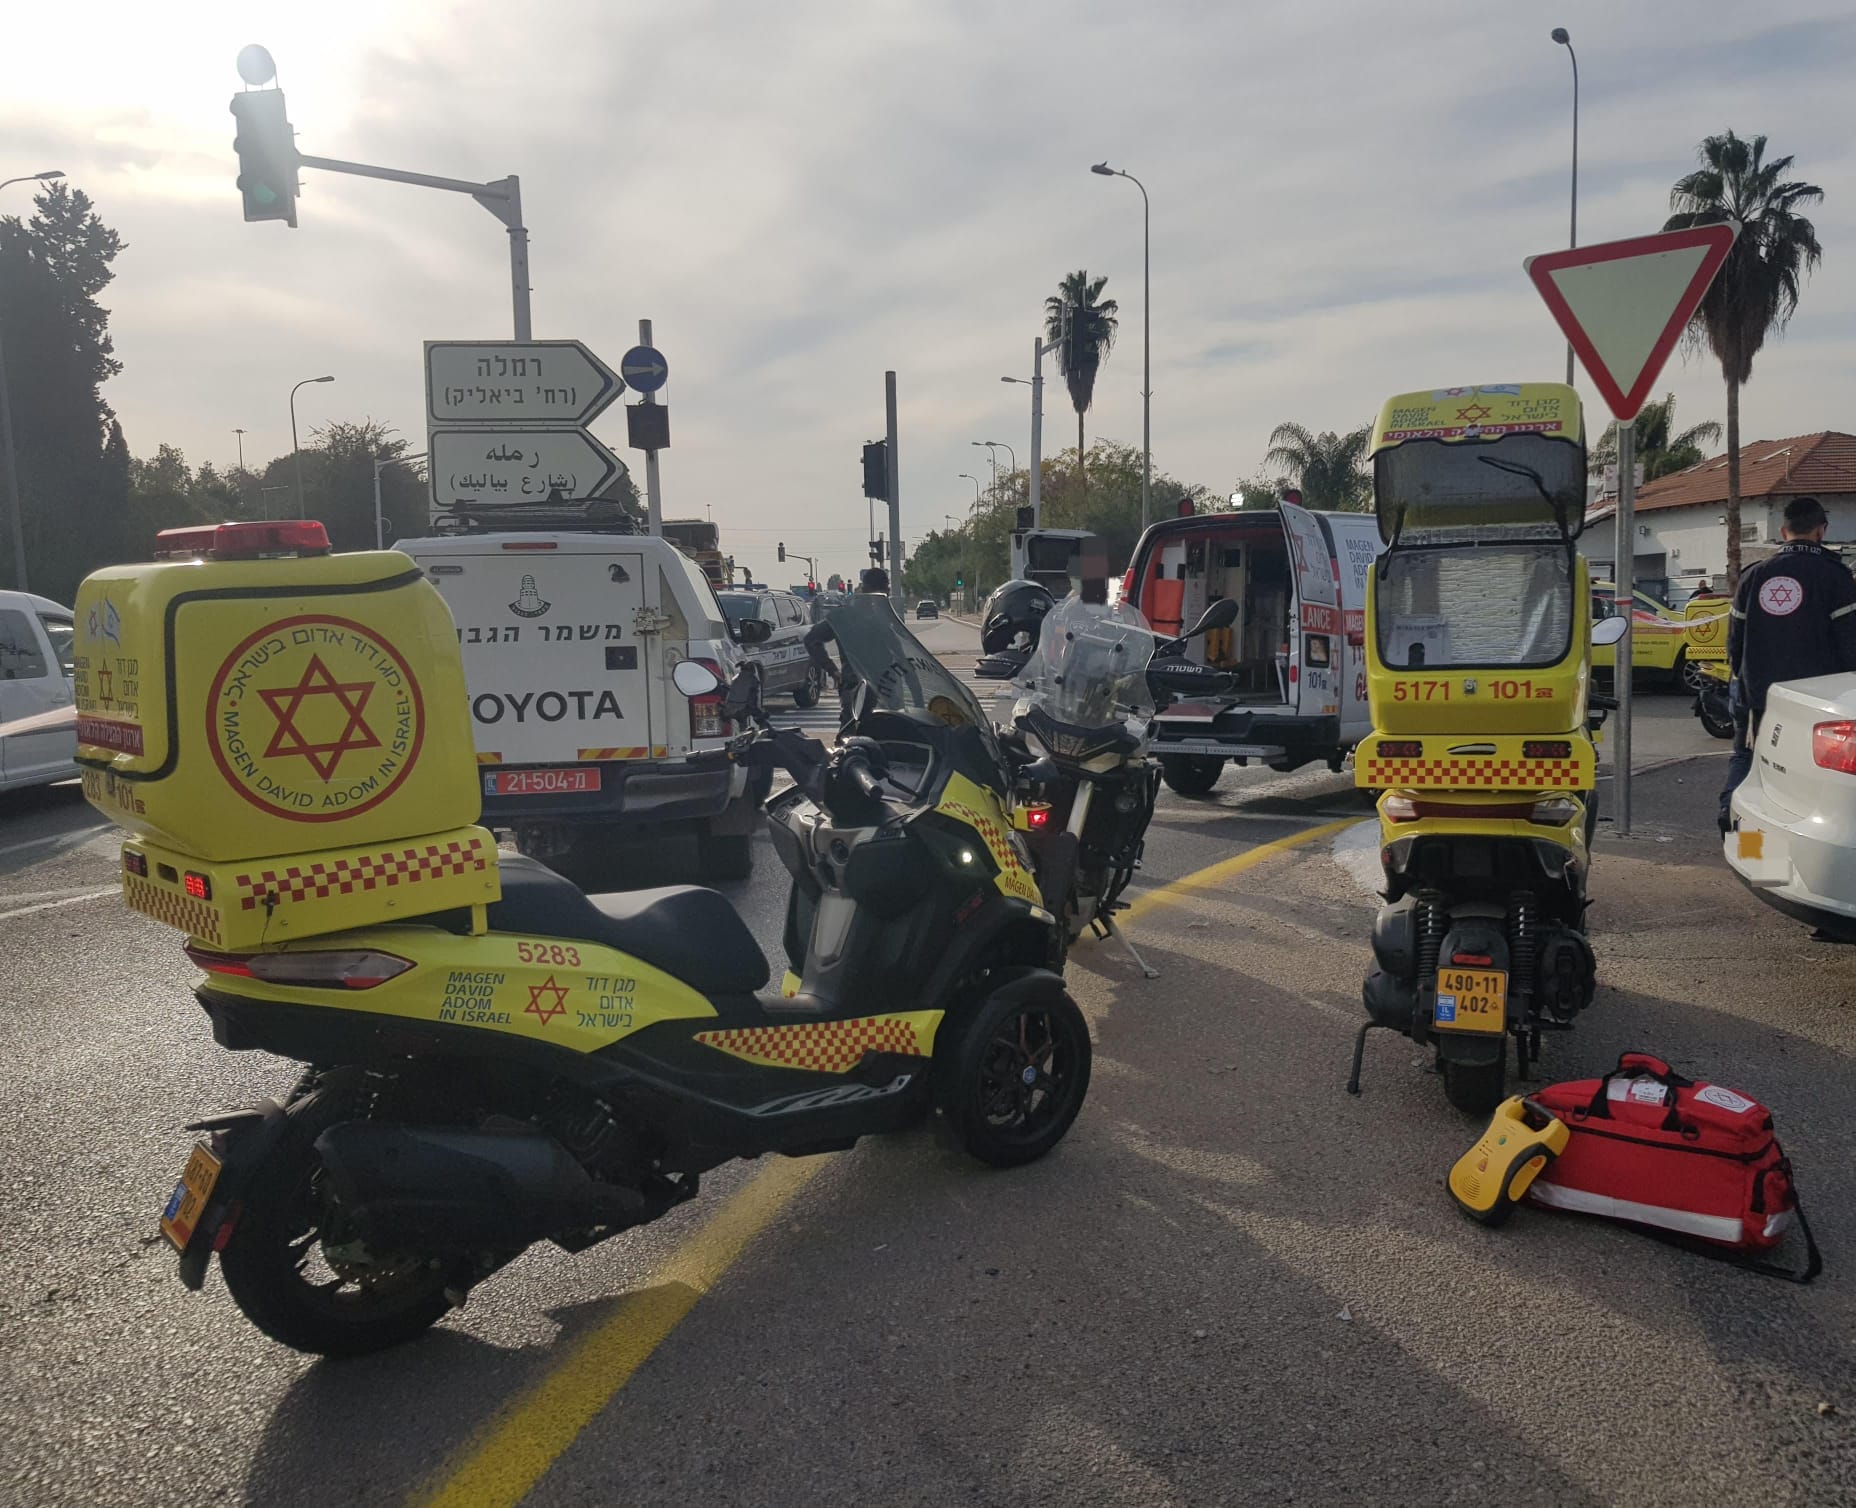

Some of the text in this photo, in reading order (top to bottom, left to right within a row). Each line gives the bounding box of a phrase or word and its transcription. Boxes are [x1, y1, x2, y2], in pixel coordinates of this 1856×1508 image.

[477, 355, 542, 377] רמלה
[445, 386, 524, 405] ביאליק)
[485, 444, 540, 468] رمله
[1345, 539, 1374, 552] MAGEN
[537, 623, 622, 642] משמר
[224, 628, 401, 700] מגן דוד אדום בישראל
[1166, 665, 1203, 674] משטרה
[1308, 671, 1322, 690] 101
[1488, 680, 1534, 700] 101
[1393, 681, 1451, 702] 5171
[468, 690, 625, 725] OYOTA
[224, 696, 411, 808] MAGEN DAVID ADOM IN ISRAEL
[116, 783, 135, 812] 101
[1004, 876, 1027, 896] MAGEN
[517, 942, 581, 967] 5283
[448, 971, 505, 985] MAGEN
[586, 977, 636, 993] מגן דוד
[1445, 974, 1498, 994] 490-11
[444, 984, 494, 997] DAVID
[442, 996, 492, 1010] ADOM
[600, 996, 634, 1010] אדום
[1460, 995, 1489, 1014] 402
[438, 1008, 512, 1025] IN ISRAEL
[576, 1010, 632, 1028] בישראל
